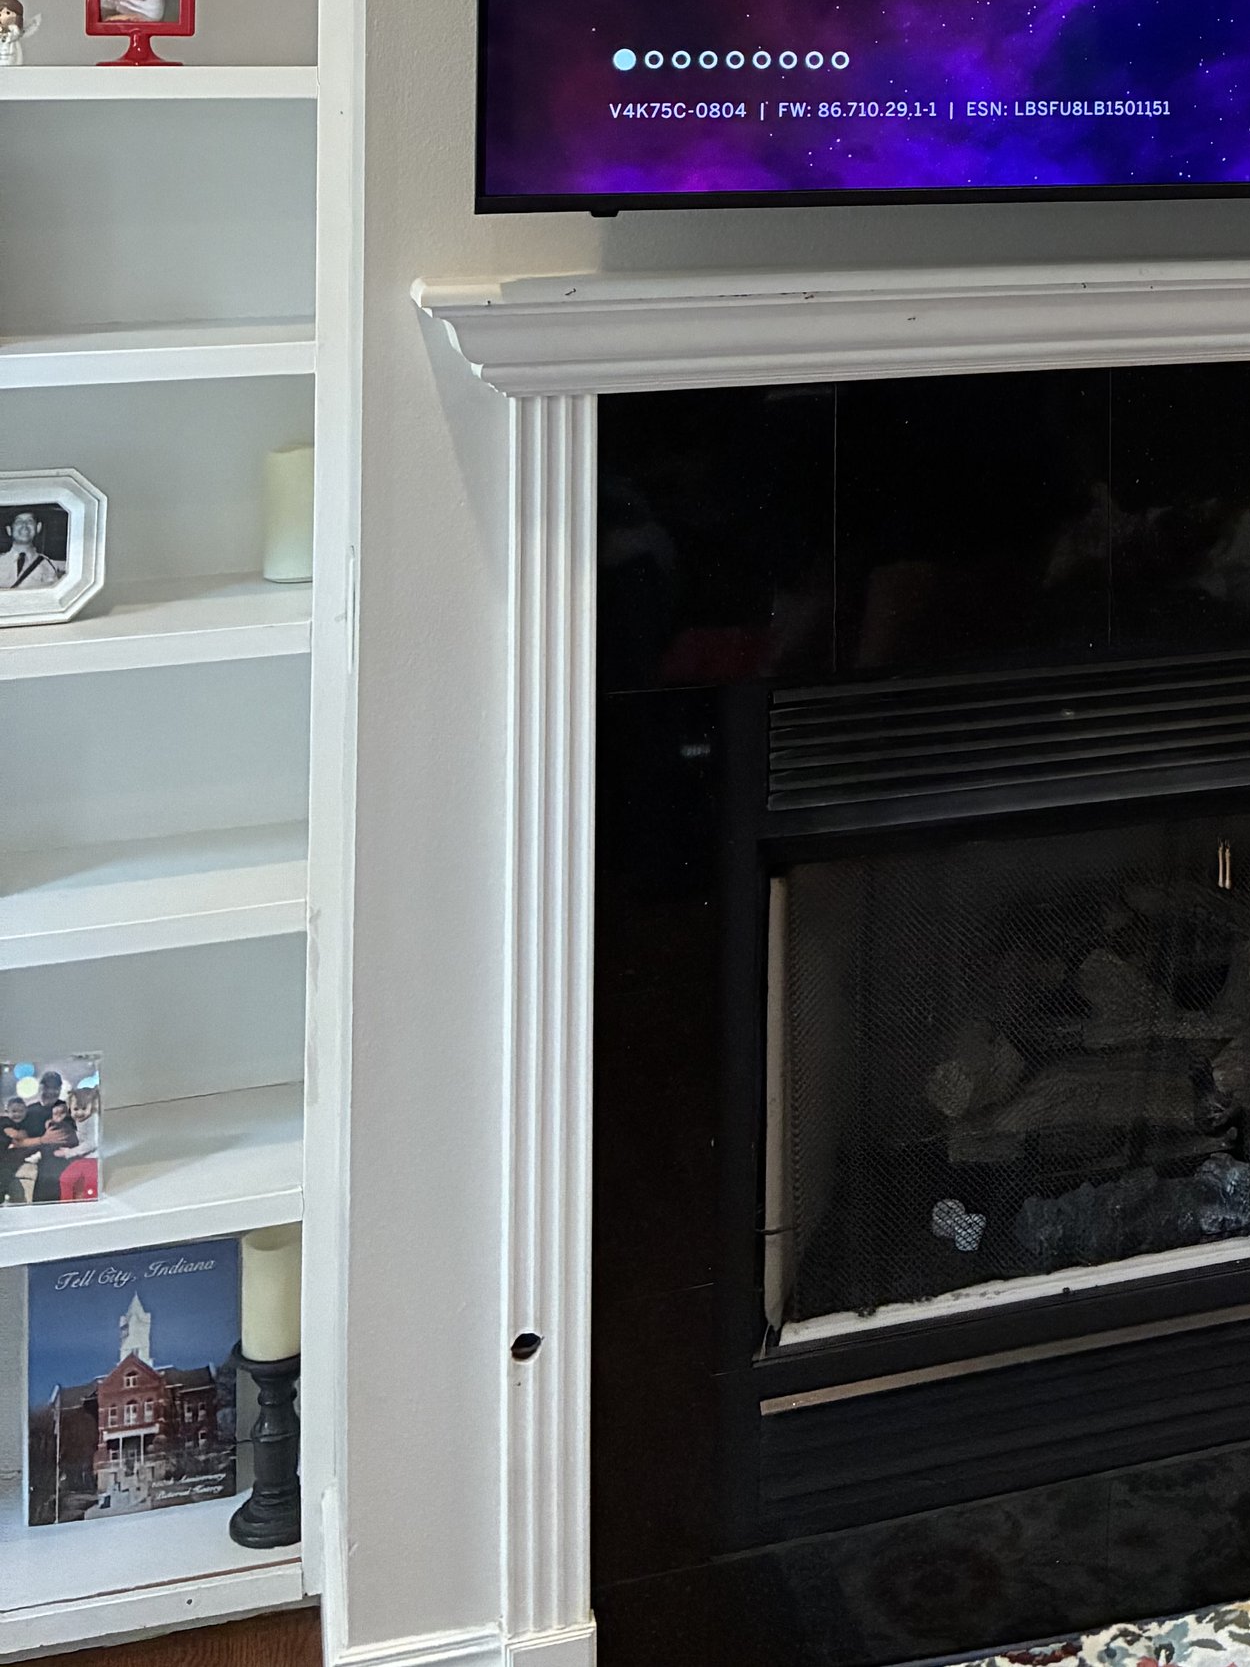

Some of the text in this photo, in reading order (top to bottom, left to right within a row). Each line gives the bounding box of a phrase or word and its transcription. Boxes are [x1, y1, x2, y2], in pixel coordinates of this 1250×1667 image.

[609, 102, 747, 119] V4K75C-0804
[778, 102, 811, 118] FW:
[818, 101, 937, 118] 86.710.29.1-1
[966, 101, 1008, 117] ESN:
[1014, 100, 1171, 117] LBSFU8LB1501151
[54, 1268, 96, 1291] Tell
[144, 1257, 216, 1279] Indiana
